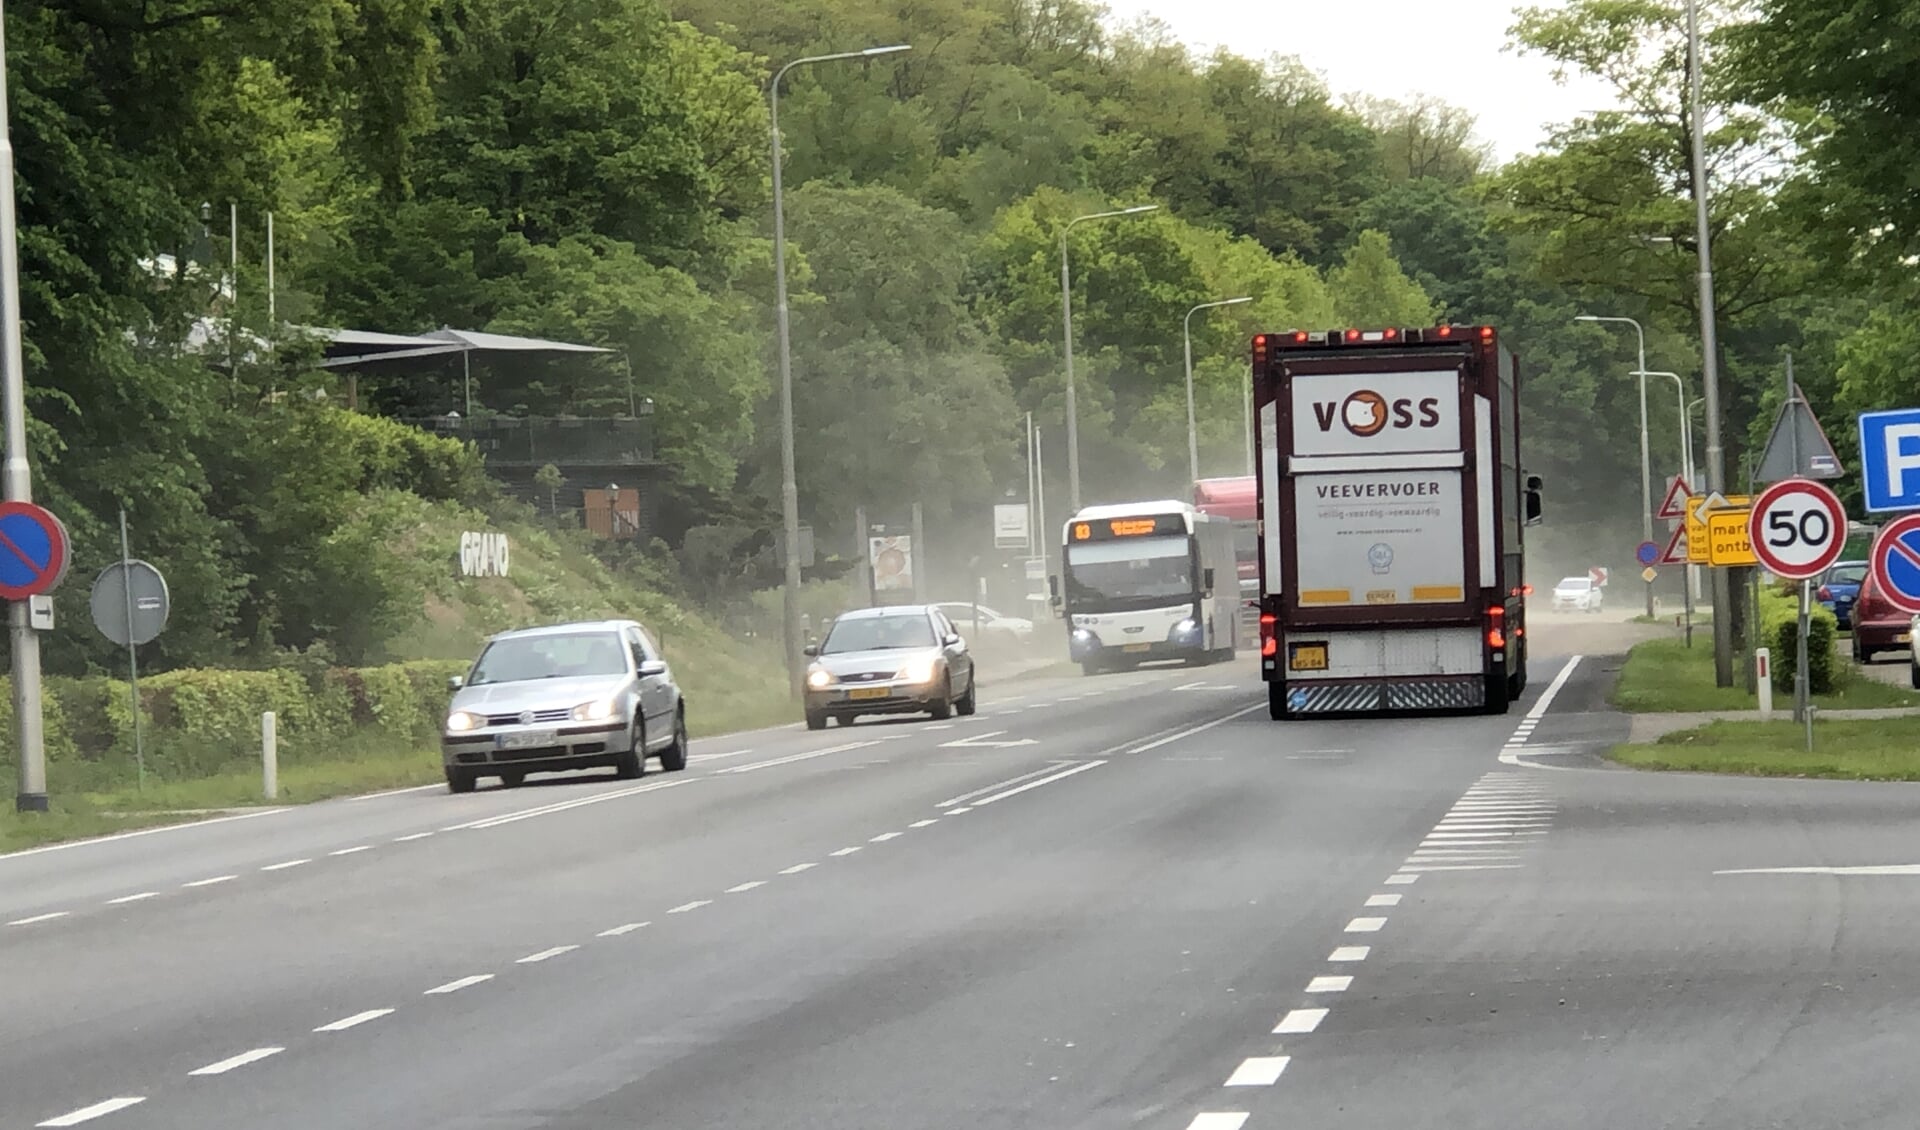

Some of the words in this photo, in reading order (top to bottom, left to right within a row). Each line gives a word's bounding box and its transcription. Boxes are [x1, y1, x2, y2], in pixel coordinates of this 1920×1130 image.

[1313, 389, 1440, 438] VOSS
[1884, 423, 1920, 498] P
[1316, 481, 1441, 499] VEEVERVOER
[1769, 509, 1829, 547] 50
